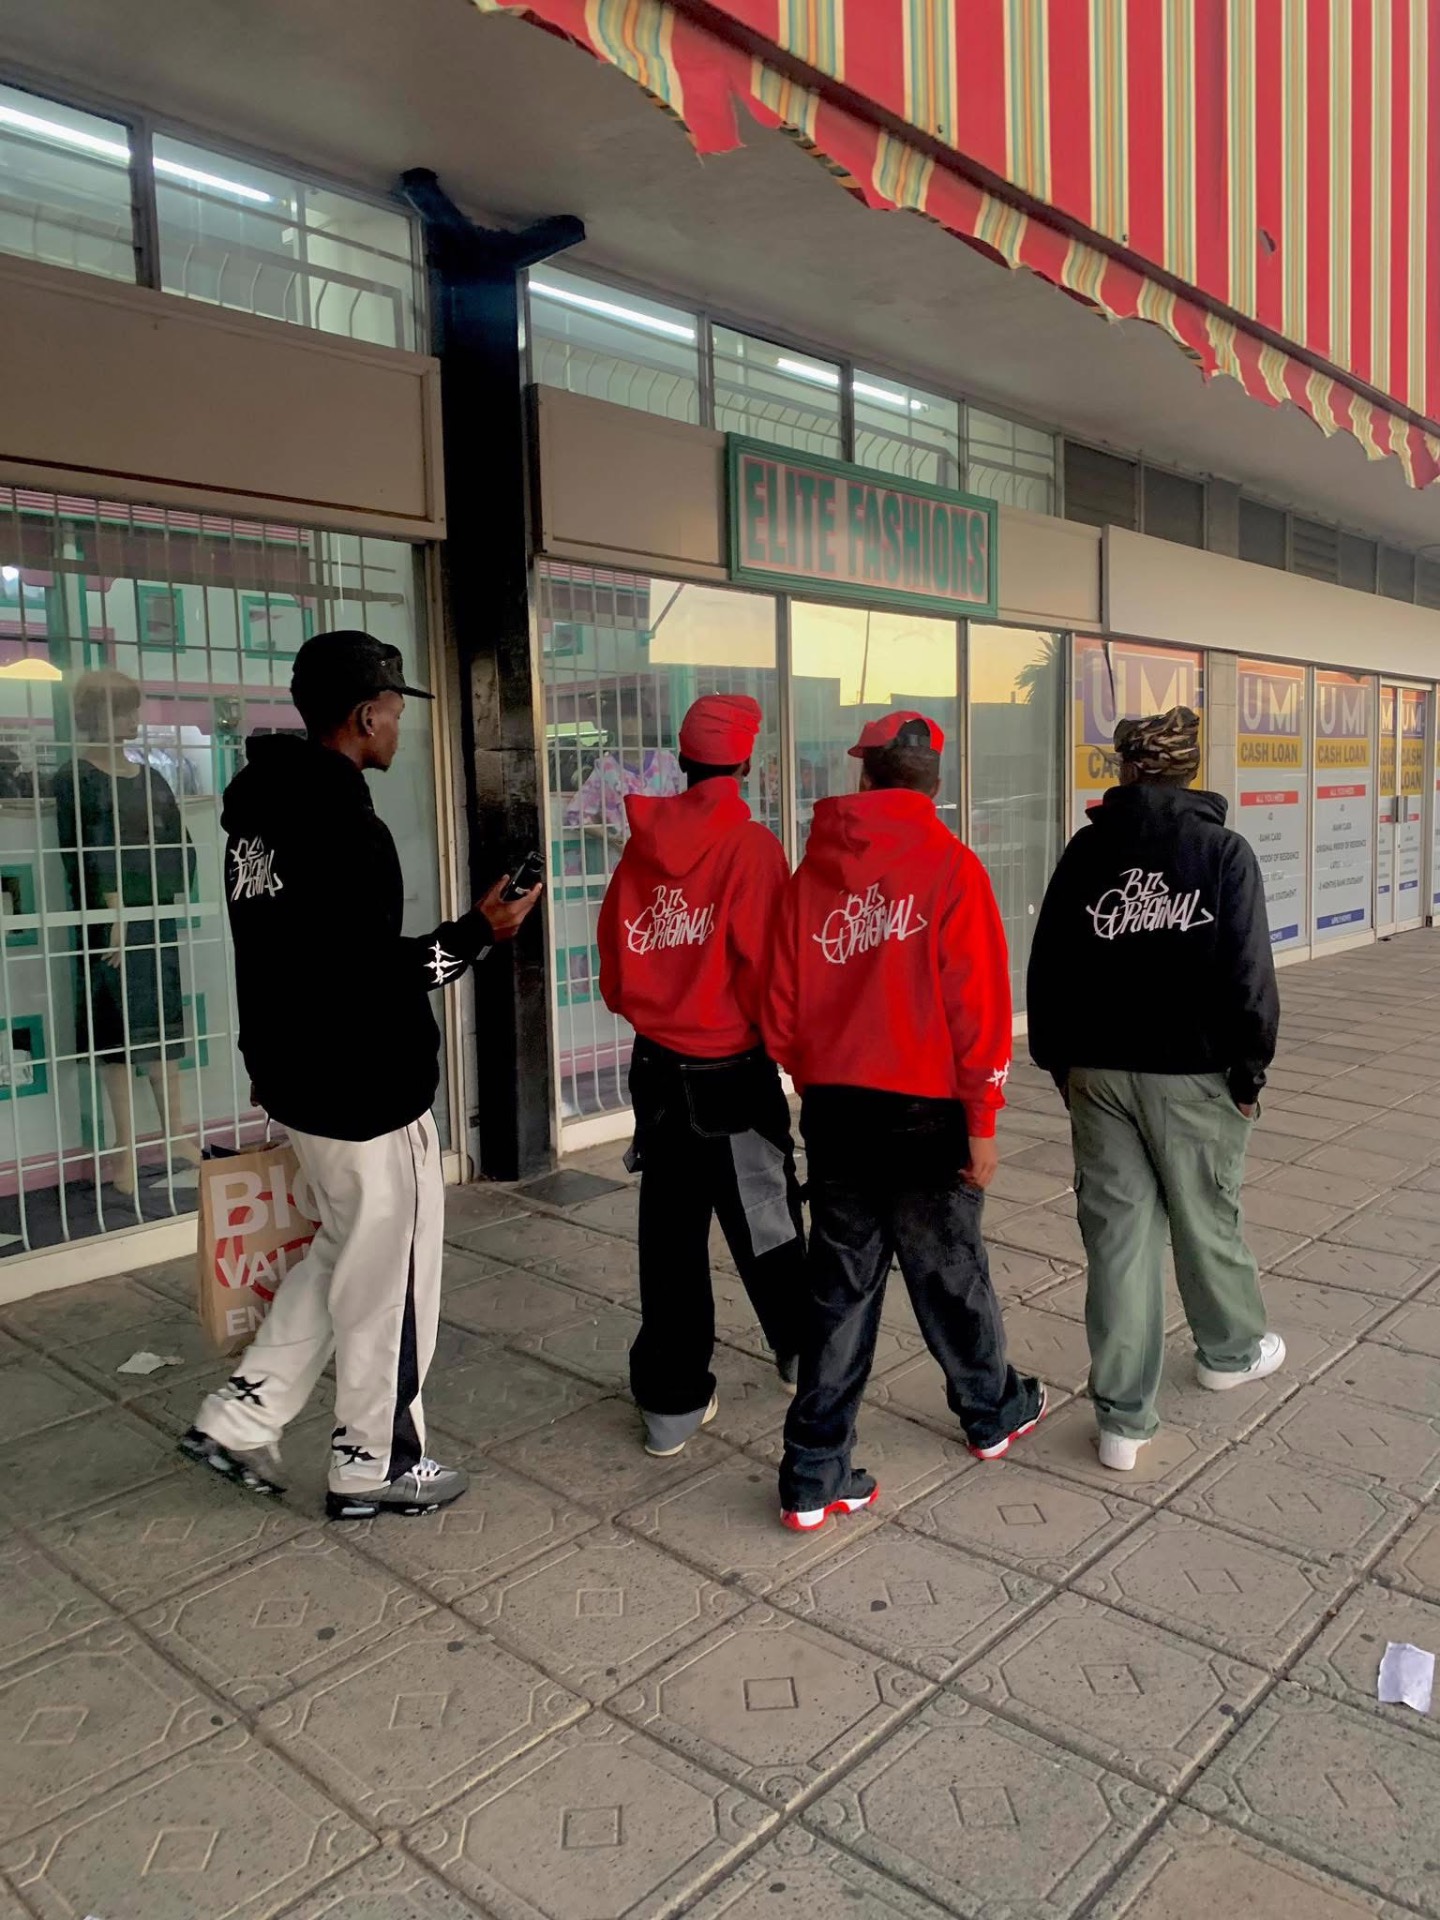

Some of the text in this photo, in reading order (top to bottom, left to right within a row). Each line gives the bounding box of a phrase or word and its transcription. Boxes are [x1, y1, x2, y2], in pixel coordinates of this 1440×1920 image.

[744, 456, 985, 600] ELITE FASHIONS
[1241, 742, 1298, 764] CASH LOAN
[1318, 745, 1341, 764] CASH
[1344, 745, 1366, 763] LOAN
